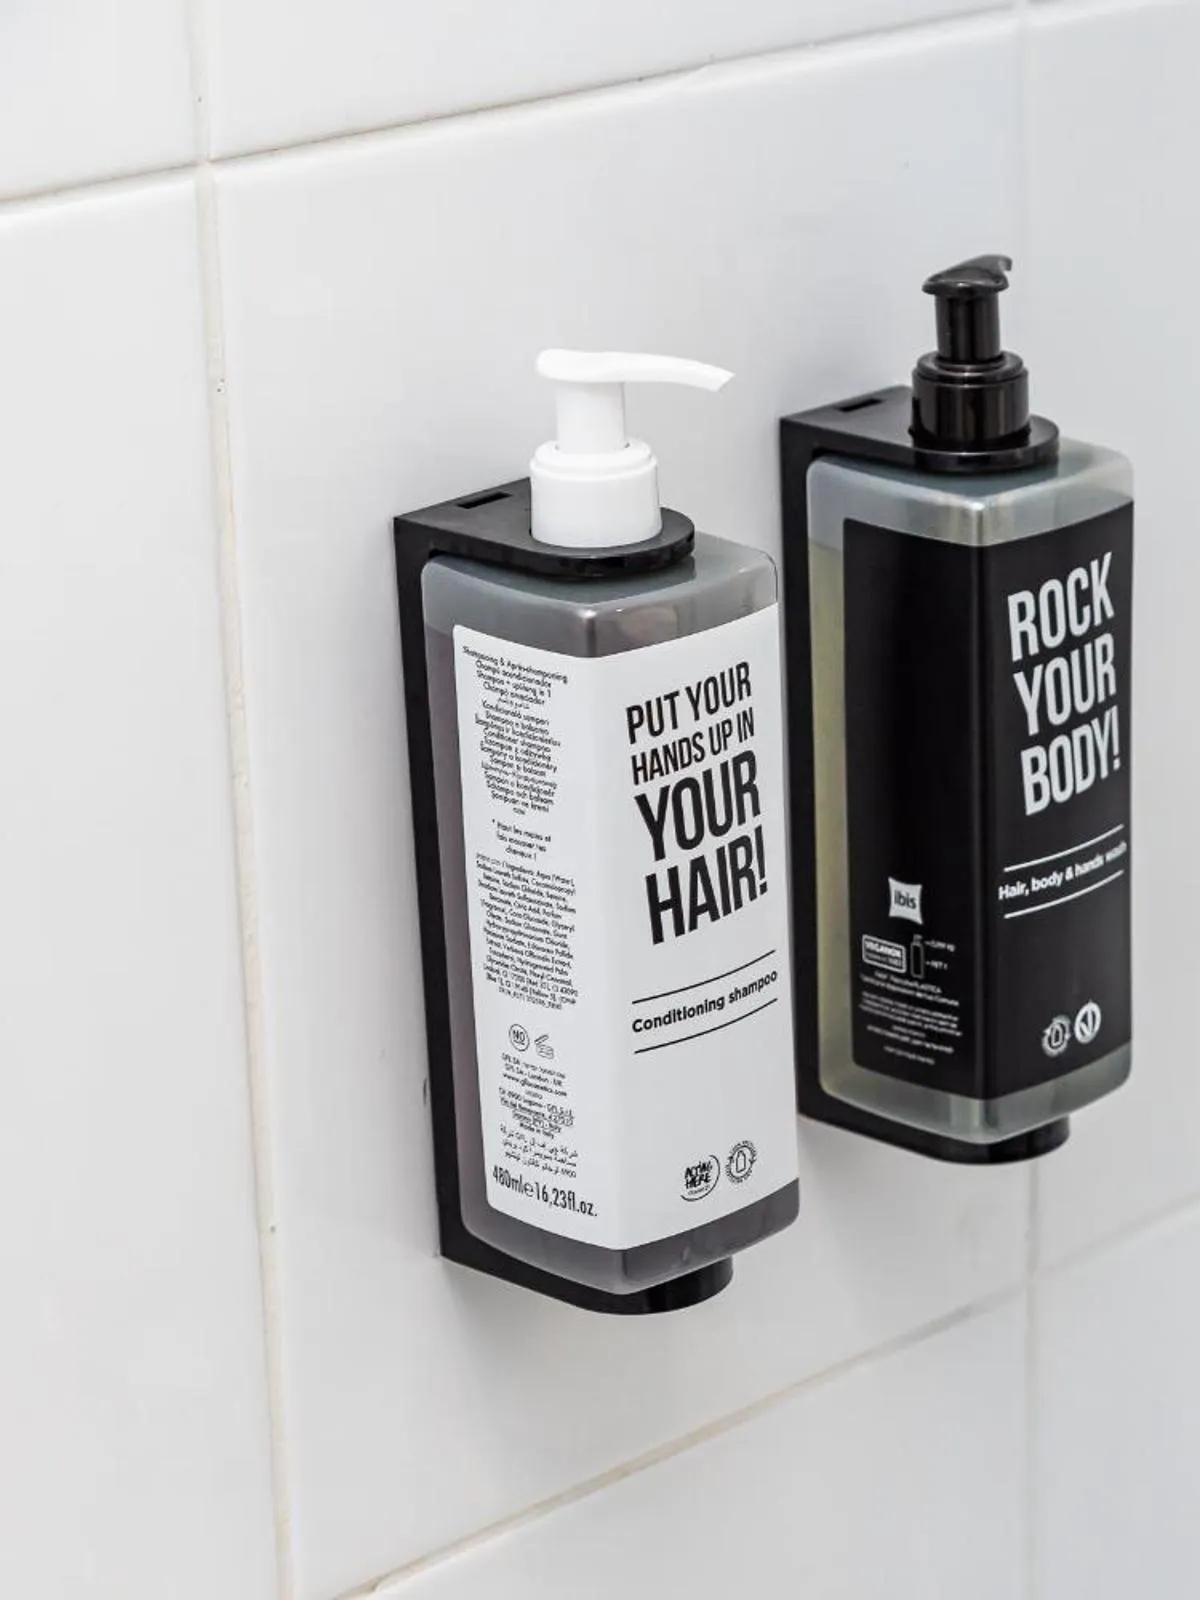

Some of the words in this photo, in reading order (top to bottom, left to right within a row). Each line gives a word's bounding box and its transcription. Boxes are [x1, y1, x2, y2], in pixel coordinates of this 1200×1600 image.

[1007, 551, 1115, 663] ROCK
[626, 689, 680, 744] PUT
[685, 661, 753, 722] YOUR
[1013, 632, 1117, 737] YOUR
[631, 731, 706, 786] HANDS
[708, 718, 733, 757] UP
[736, 706, 755, 744] IN
[1020, 704, 1121, 817] BODY!
[634, 750, 761, 862] YOUR
[645, 824, 768, 945] HAIR!
[894, 889, 917, 910] ibis
[998, 881, 1029, 900] Hair,
[1031, 871, 1064, 892] body
[632, 996, 726, 1033] Conditioning
[729, 971, 778, 1004] shampoo
